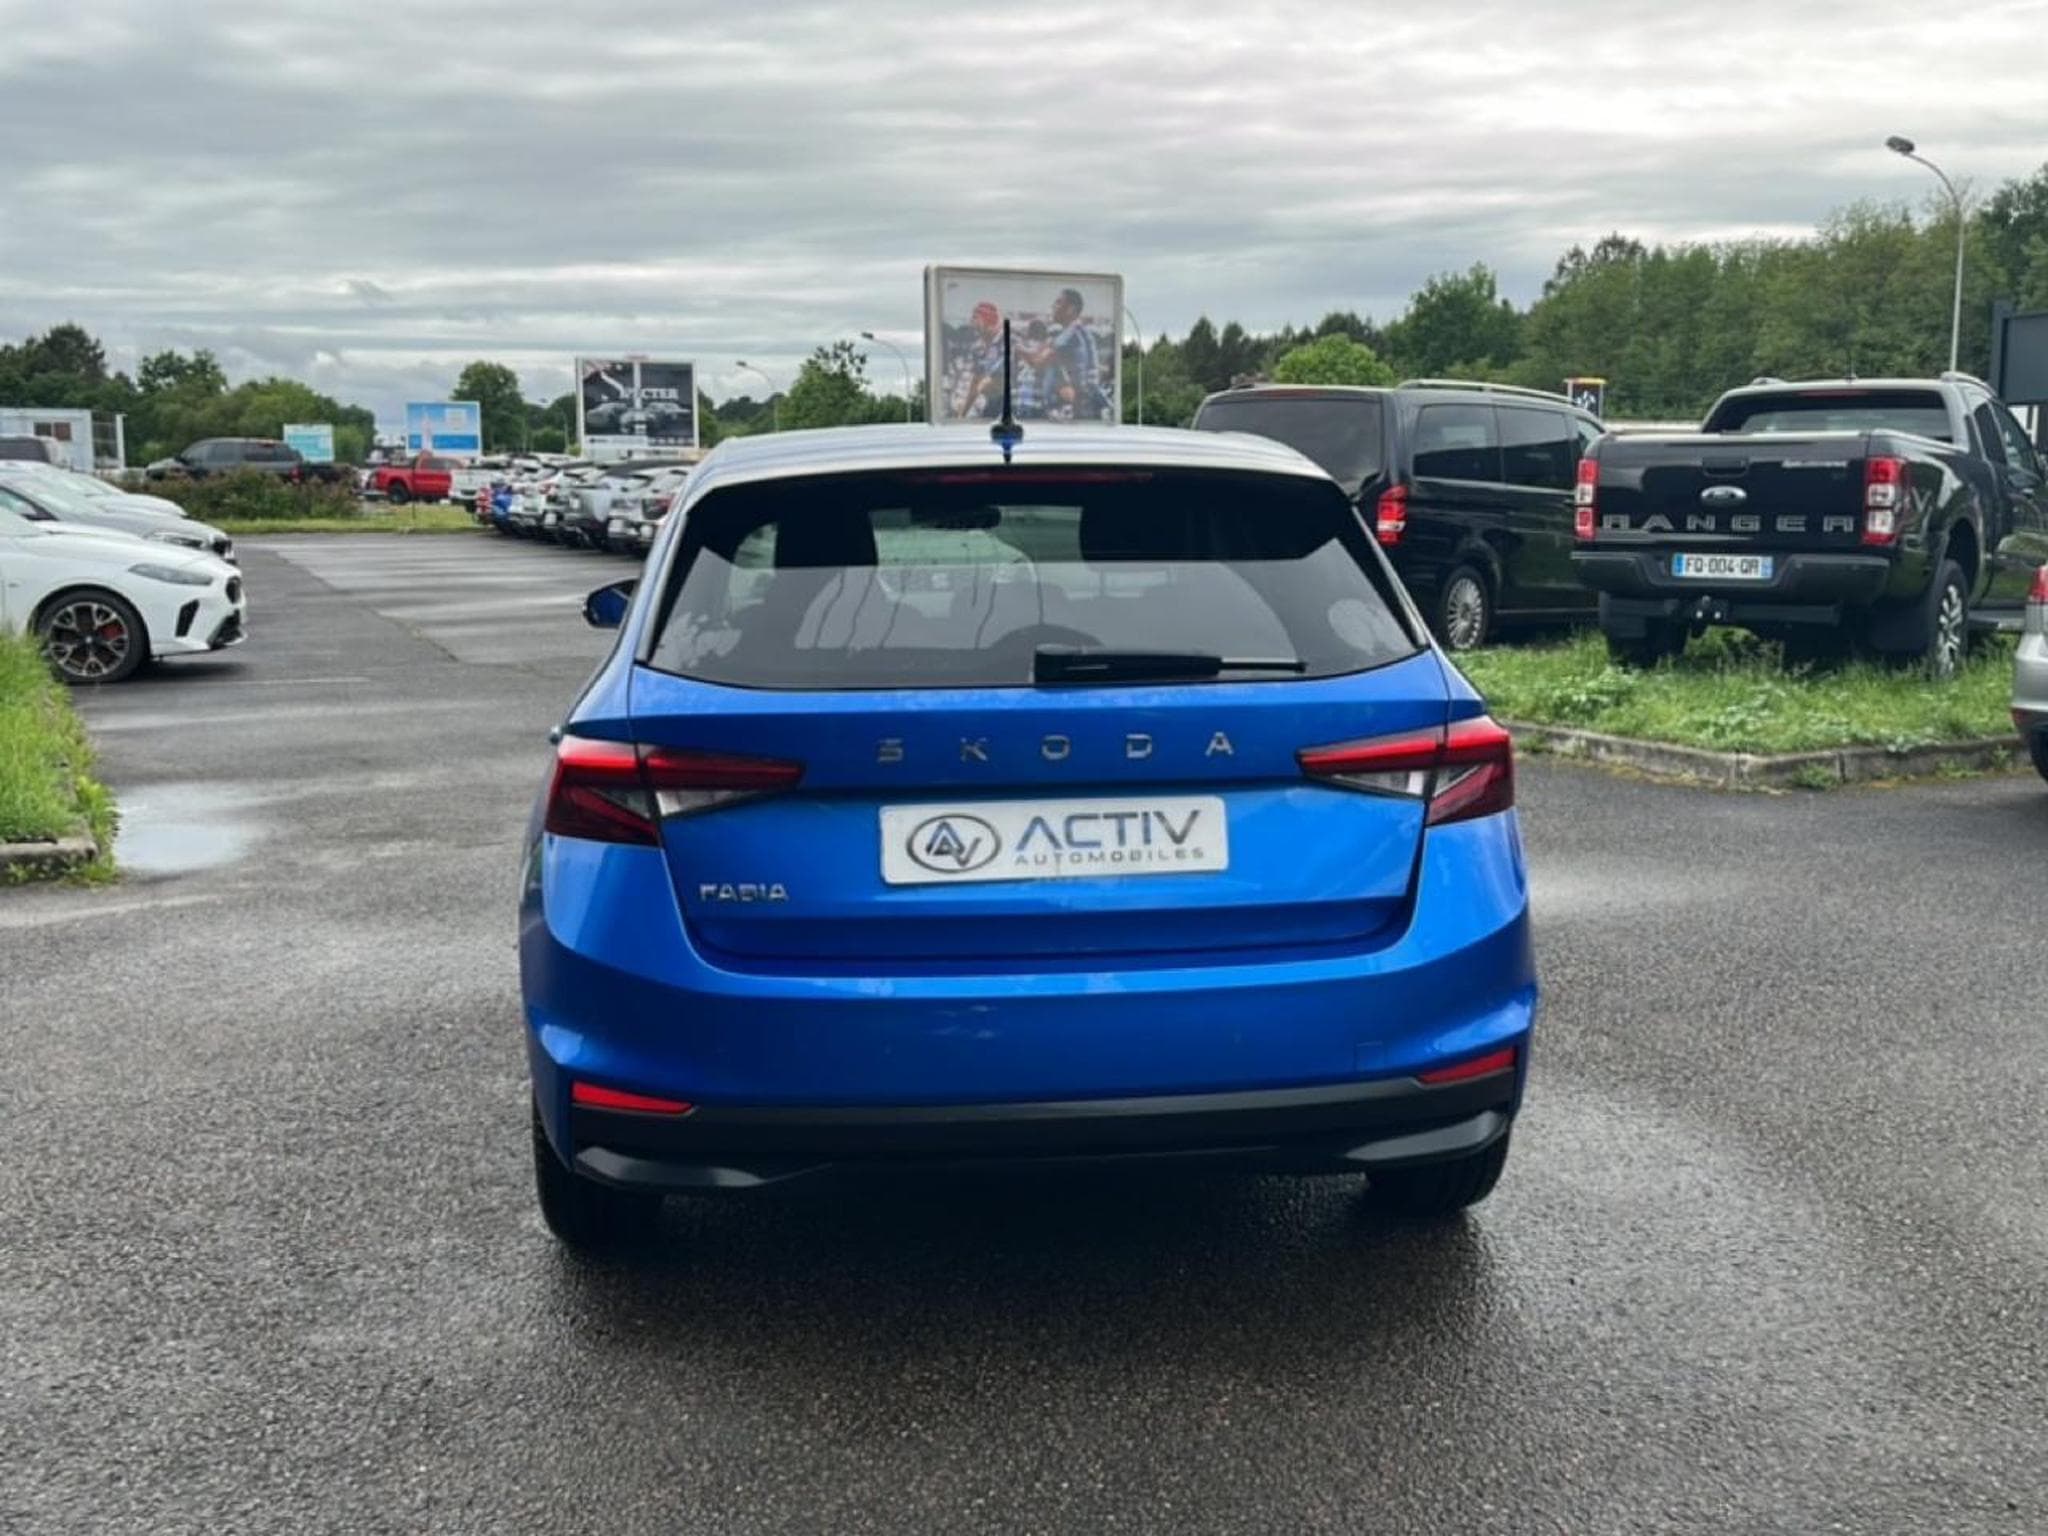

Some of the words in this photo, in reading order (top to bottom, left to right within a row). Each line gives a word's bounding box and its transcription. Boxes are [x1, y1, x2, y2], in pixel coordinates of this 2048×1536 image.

[1602, 513, 1855, 533] RANGER
[876, 731, 1234, 763] SKODA
[1015, 809, 1201, 851] ACTIV
[1014, 847, 1205, 866] AUTOMOBILES
[700, 883, 790, 902] FABIA
